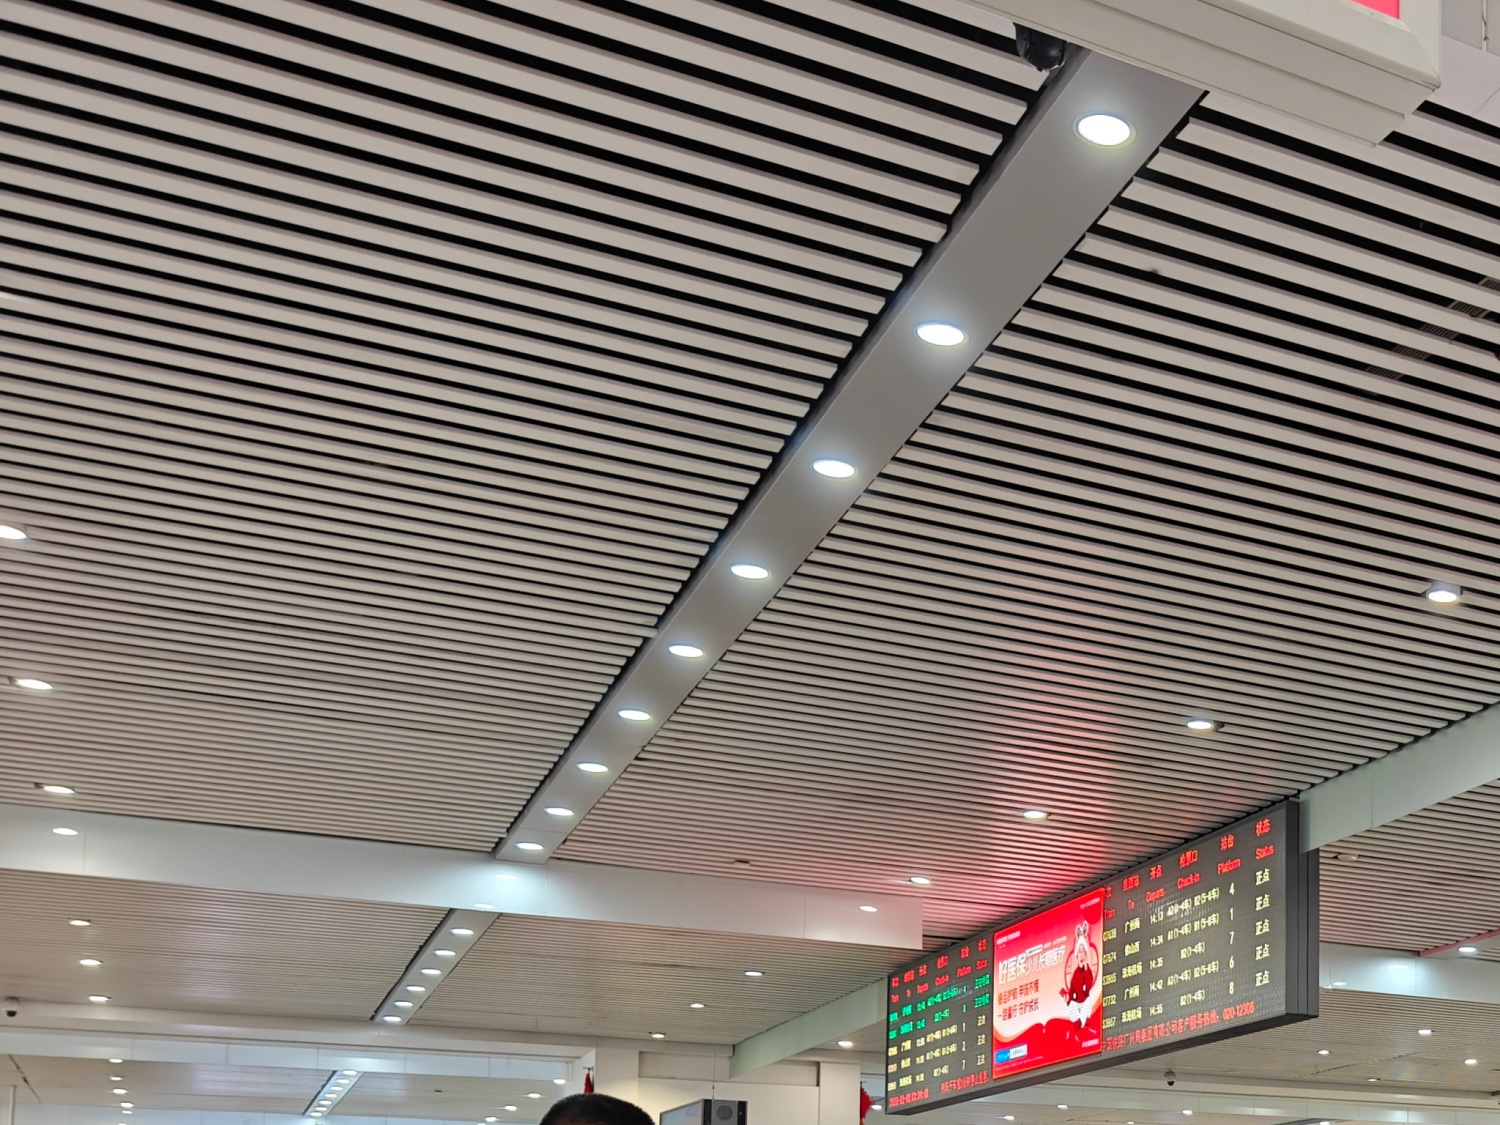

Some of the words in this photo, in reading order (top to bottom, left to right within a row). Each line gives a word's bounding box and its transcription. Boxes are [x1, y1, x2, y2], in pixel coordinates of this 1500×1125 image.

[1255, 818, 1271, 836] 状态
[1229, 882, 1235, 895] 4
[1255, 868, 1270, 886] 正点
[1229, 907, 1234, 921] 1
[1255, 894, 1270, 911] 正点
[1229, 931, 1235, 945] 7
[1255, 919, 1270, 936] 正点
[1229, 956, 1235, 969] 6
[1255, 943, 1270, 960] 正点
[1229, 981, 1235, 995] 8
[1255, 970, 1270, 987] 正点
